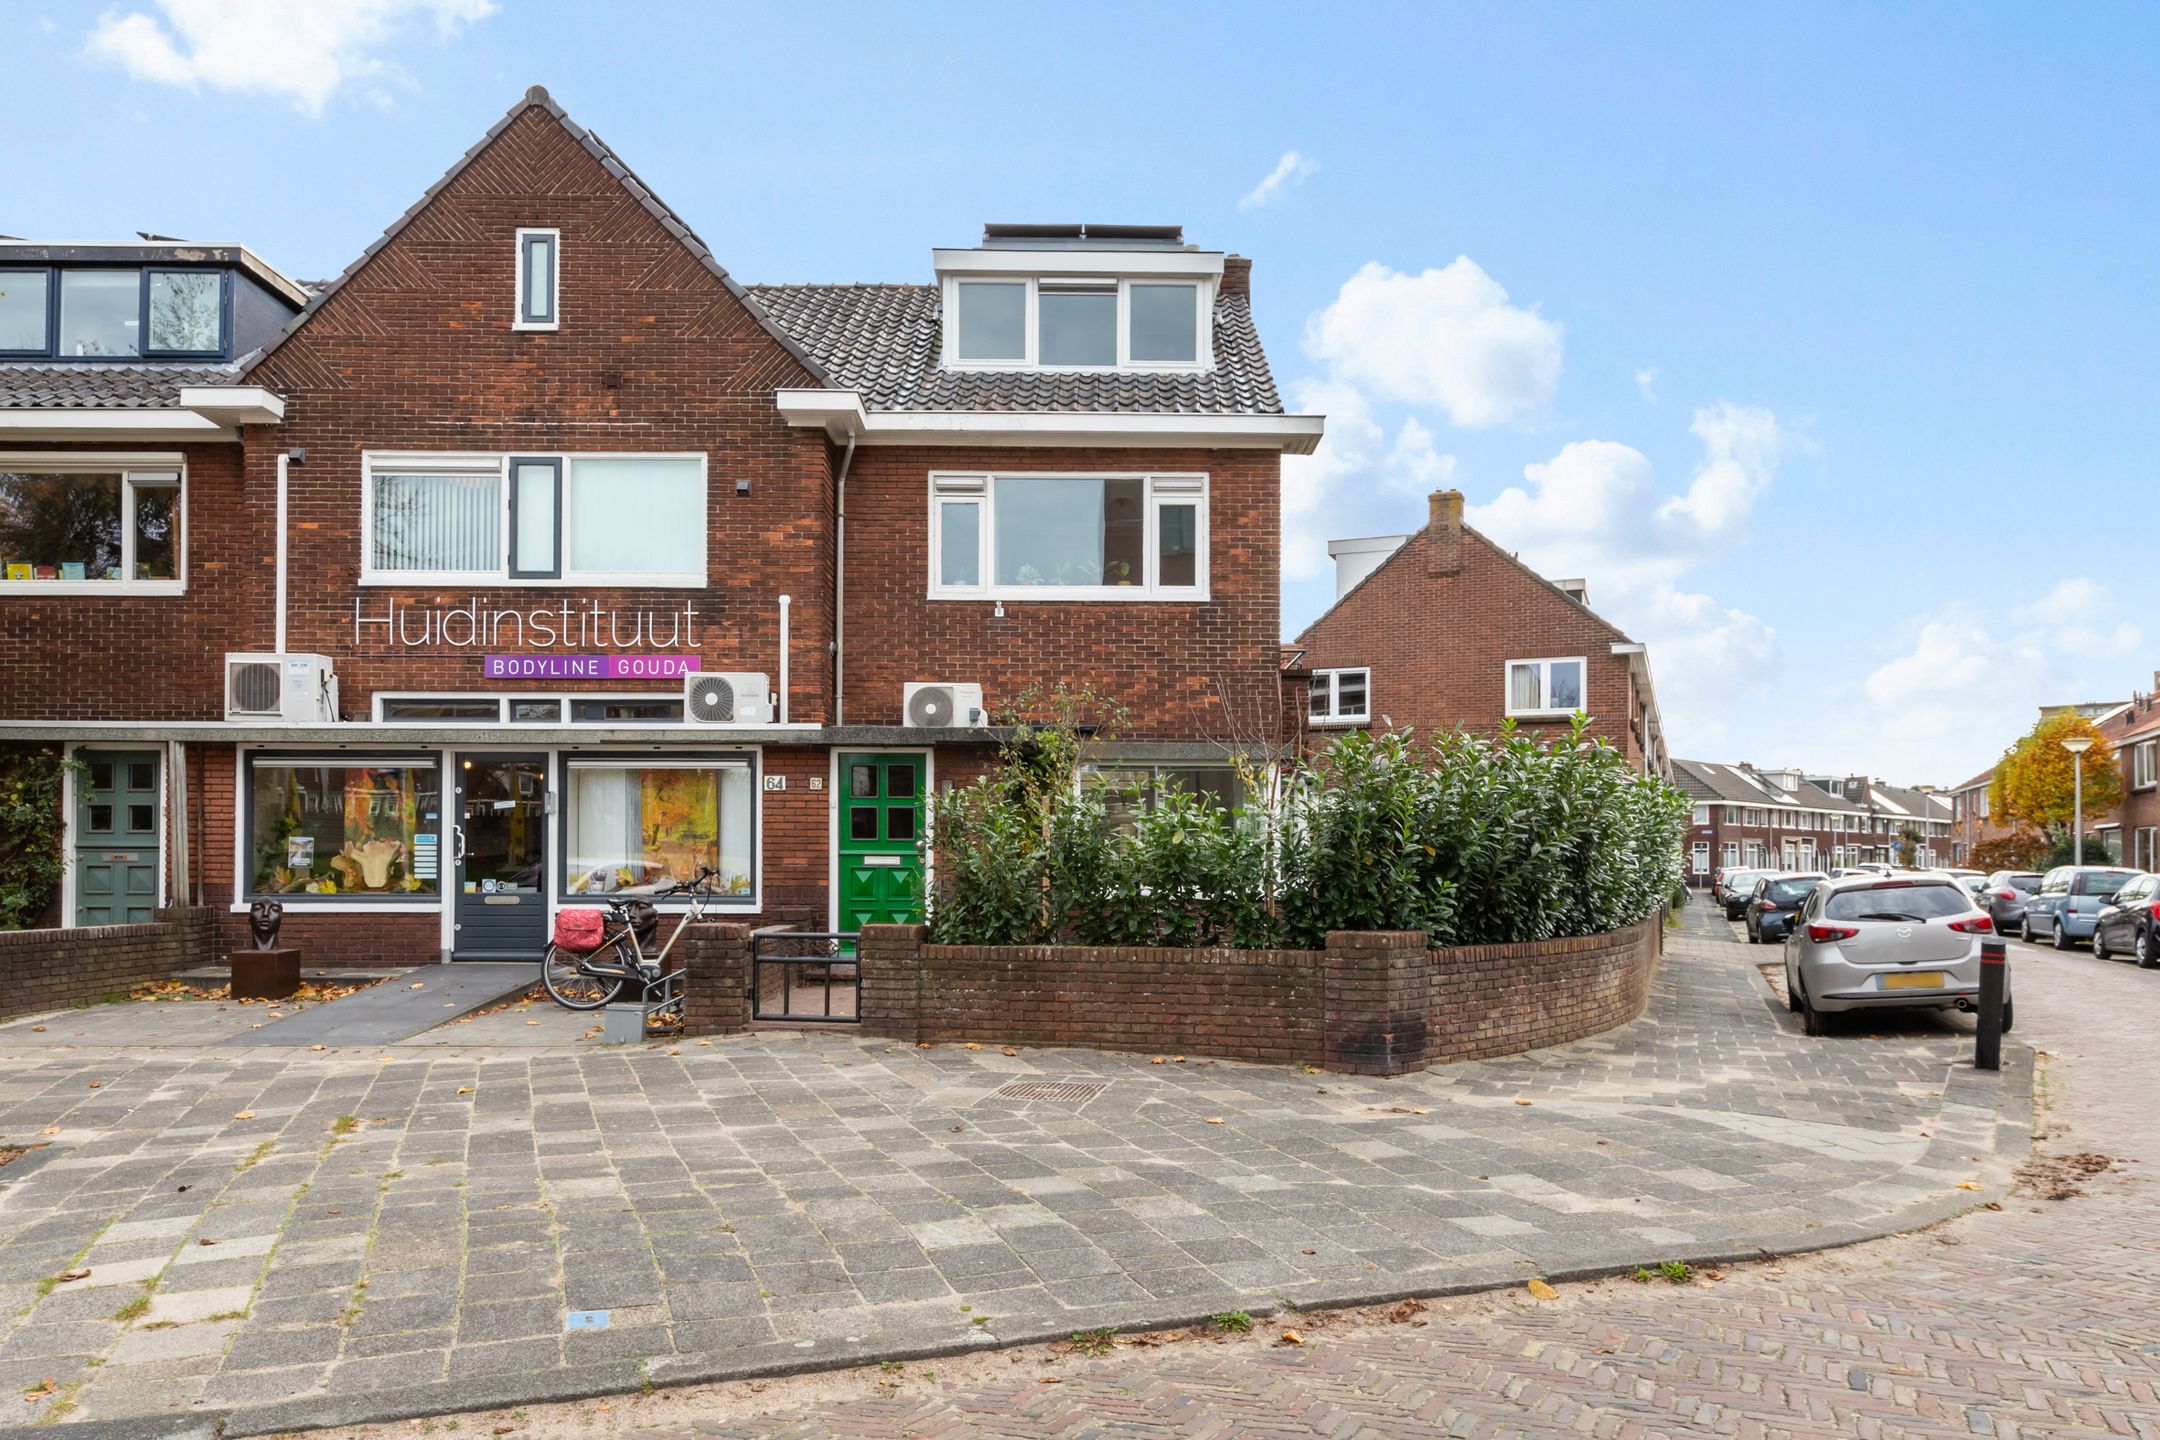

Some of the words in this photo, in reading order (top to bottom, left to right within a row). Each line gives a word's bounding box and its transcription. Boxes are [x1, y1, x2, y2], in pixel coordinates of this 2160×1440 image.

[354, 596, 702, 647] Huidinstituut
[493, 659, 599, 675] BODYLINE
[618, 659, 689, 675] GOUDA
[766, 776, 784, 790] 64
[811, 779, 822, 789] 62
